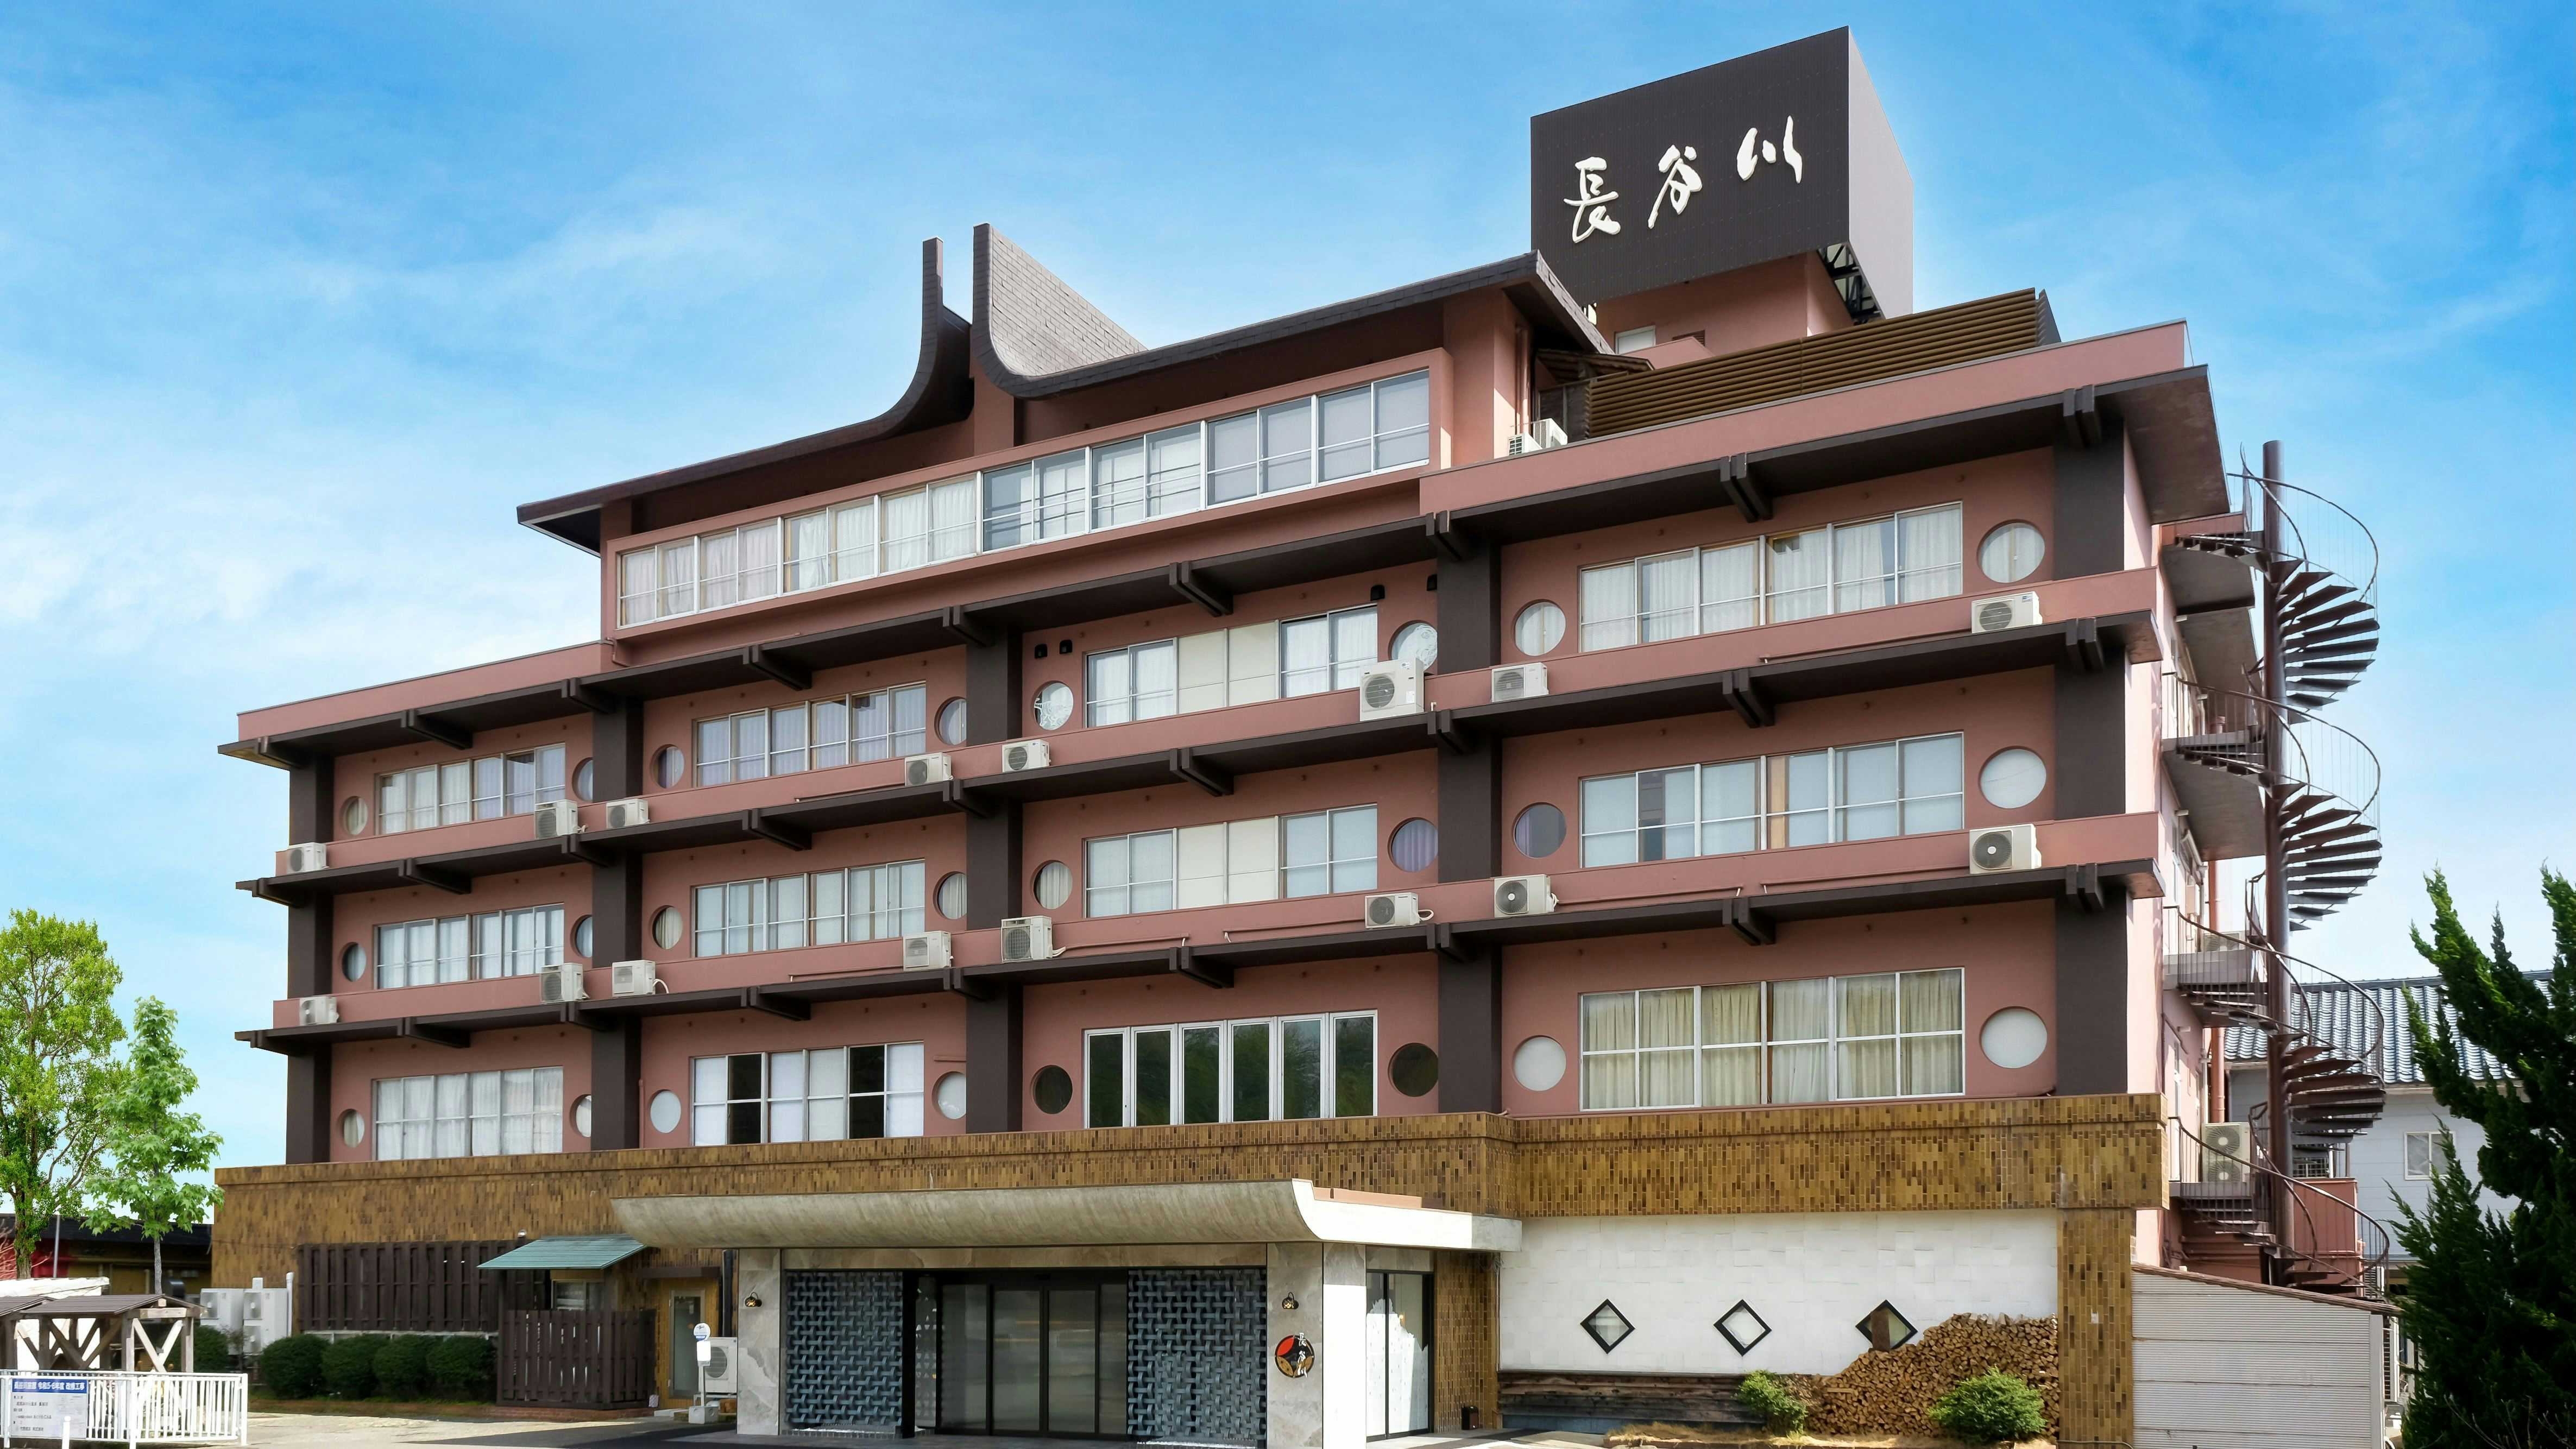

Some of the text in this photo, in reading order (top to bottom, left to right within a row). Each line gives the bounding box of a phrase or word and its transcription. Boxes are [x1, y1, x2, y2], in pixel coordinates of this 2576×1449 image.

[1564, 115, 1803, 243] 長谷川
[1298, 1332, 1307, 1378] 長谷川
